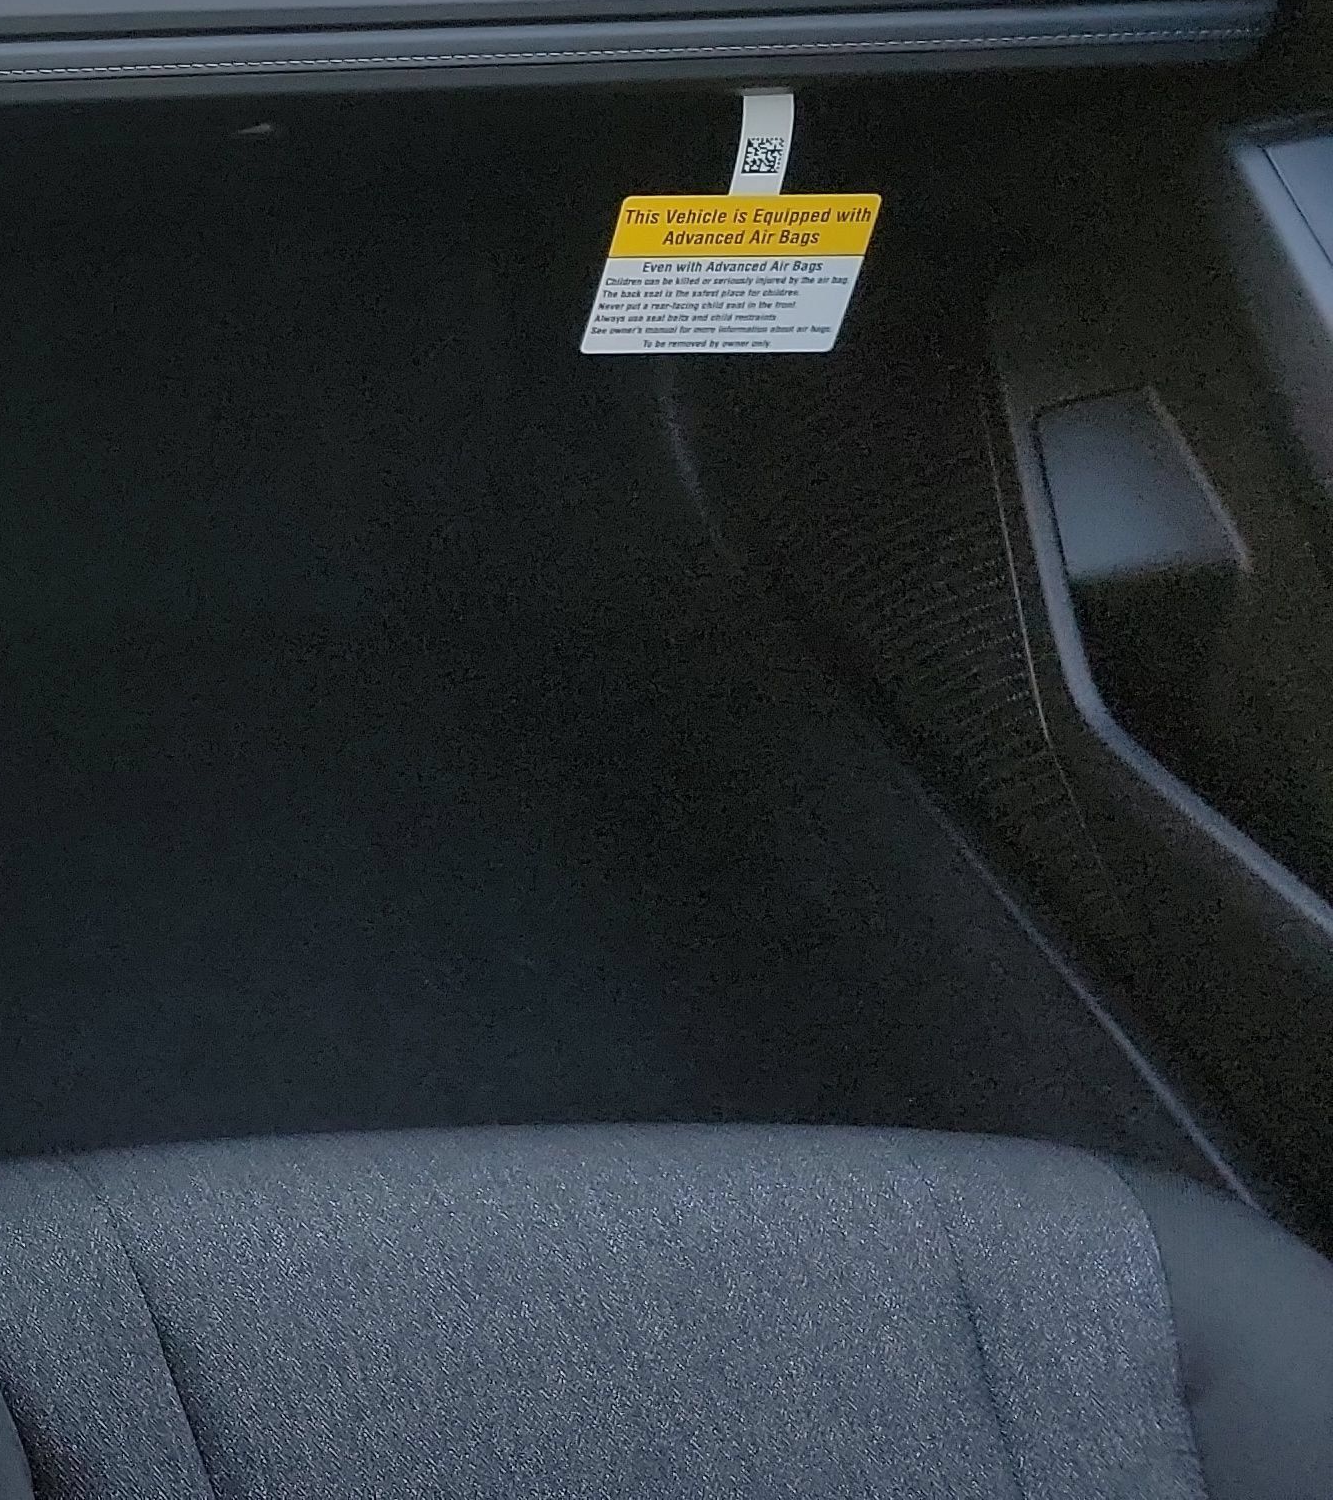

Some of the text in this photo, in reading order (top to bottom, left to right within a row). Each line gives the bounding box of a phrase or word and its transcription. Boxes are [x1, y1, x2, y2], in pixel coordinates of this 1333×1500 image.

[625, 206, 872, 226] This Vehicle is Equipped with
[661, 229, 821, 247] Advanced Air Bags
[642, 260, 824, 274] Even with Advanced Air Bags
